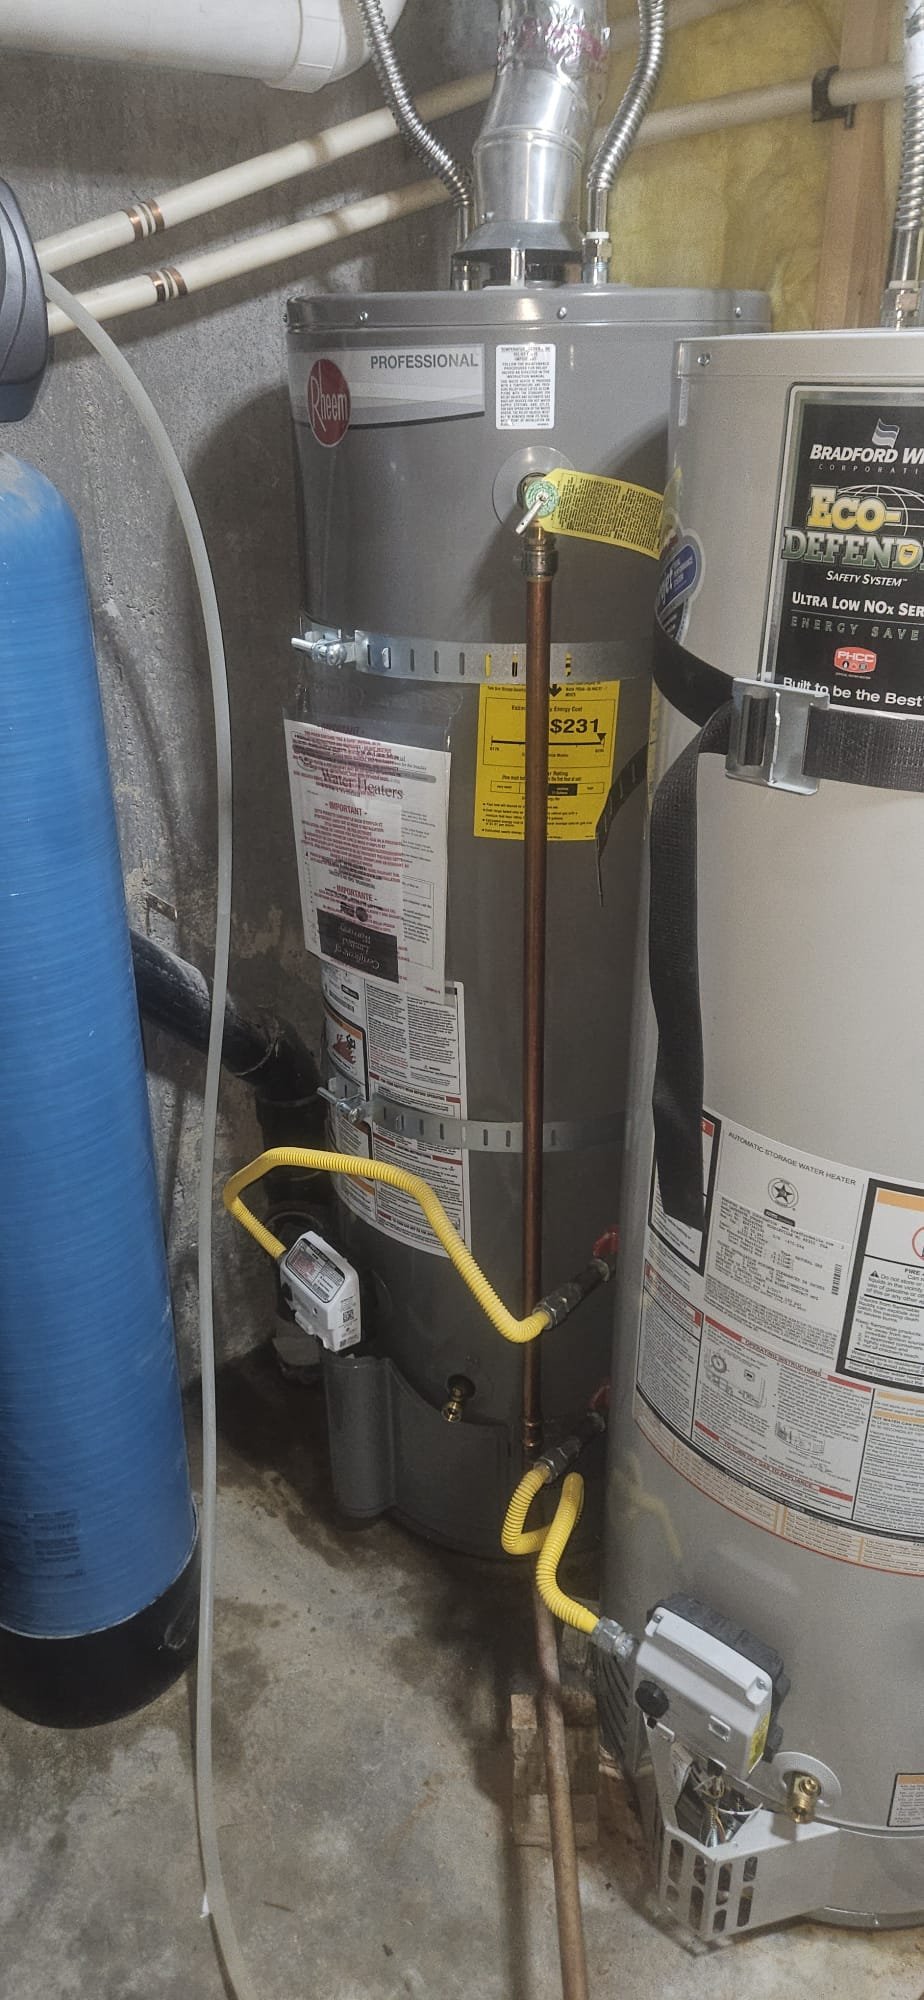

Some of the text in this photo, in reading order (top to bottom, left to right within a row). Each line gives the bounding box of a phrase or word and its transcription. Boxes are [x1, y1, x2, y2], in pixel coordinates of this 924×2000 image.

[371, 353, 478, 369] PROFESSIONAL
[310, 361, 348, 433] Rheem
[809, 444, 898, 463] BRADFORD
[781, 527, 924, 571] DEFEND
[826, 570, 861, 583] SAFETY
[792, 591, 828, 608] ULTRA
[832, 596, 860, 611] LOW
[790, 616, 859, 635] ENERGY
[837, 651, 875, 662] PHCC
[814, 682, 829, 694] to
[832, 685, 852, 698] be
[855, 689, 880, 702] the
[549, 718, 599, 735] $231
[356, 772, 404, 800] Heaters
[728, 1131, 857, 1186] AUTOMATIC STORAGE WATER HEATER
